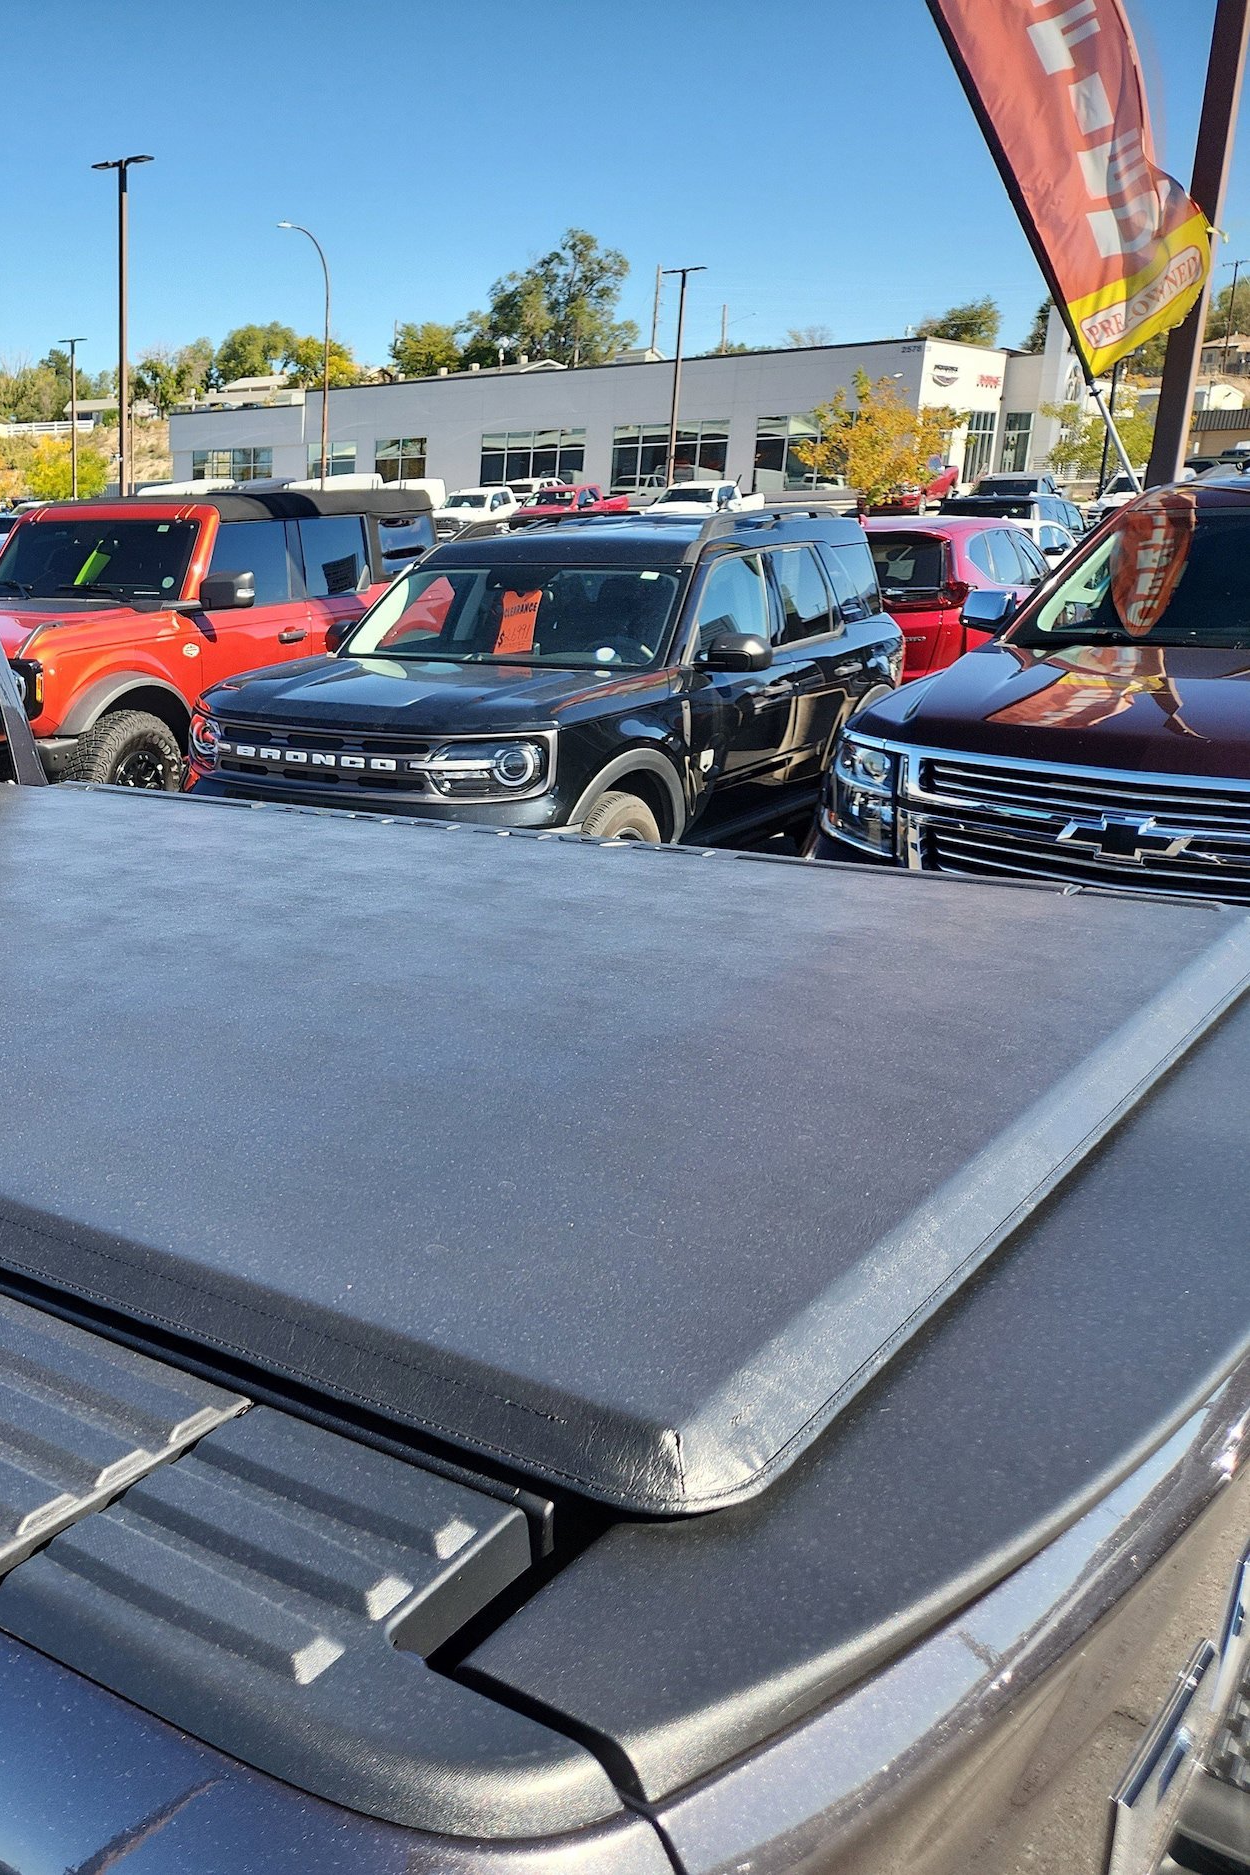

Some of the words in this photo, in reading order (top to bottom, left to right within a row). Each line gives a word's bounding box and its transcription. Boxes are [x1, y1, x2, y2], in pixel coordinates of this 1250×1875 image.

[1026, 0, 1161, 258] FIED
[1086, 256, 1199, 345] PRE-OWNED
[503, 602, 538, 618] CLEARANCE
[236, 745, 397, 771] BRONCO
